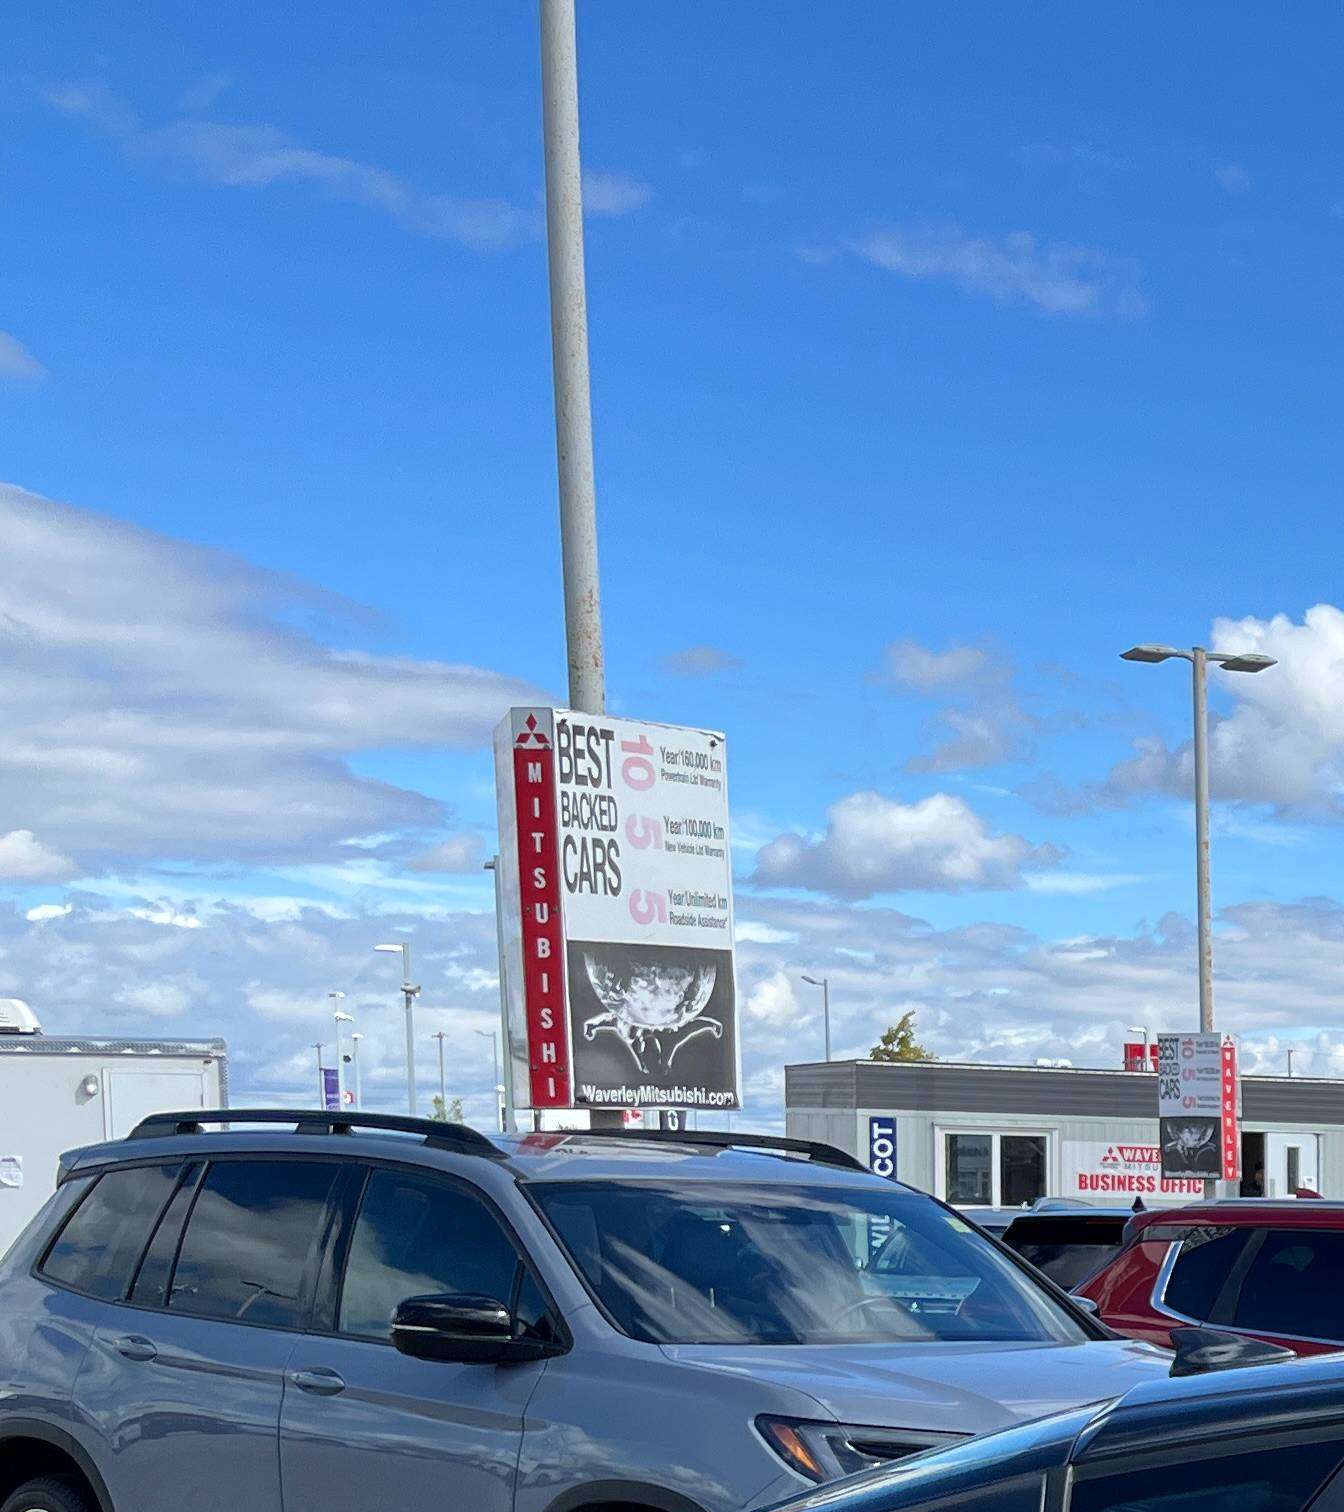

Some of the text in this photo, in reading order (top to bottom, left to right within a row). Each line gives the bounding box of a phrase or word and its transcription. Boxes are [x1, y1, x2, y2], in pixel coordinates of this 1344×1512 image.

[558, 722, 615, 789] BEST
[621, 735, 655, 791] 10
[562, 794, 618, 833] BACKED
[625, 814, 663, 850] 5
[563, 837, 622, 897] CARS
[629, 889, 667, 924] 5
[528, 762, 556, 1098] MITSUBISHI
[582, 1085, 734, 1106] WaverleyMitsubishi.com
[1122, 1148, 1160, 1161] WAVE
[1078, 1173, 1156, 1193] BUSINESS
[1160, 1178, 1203, 1193] OFFIC
